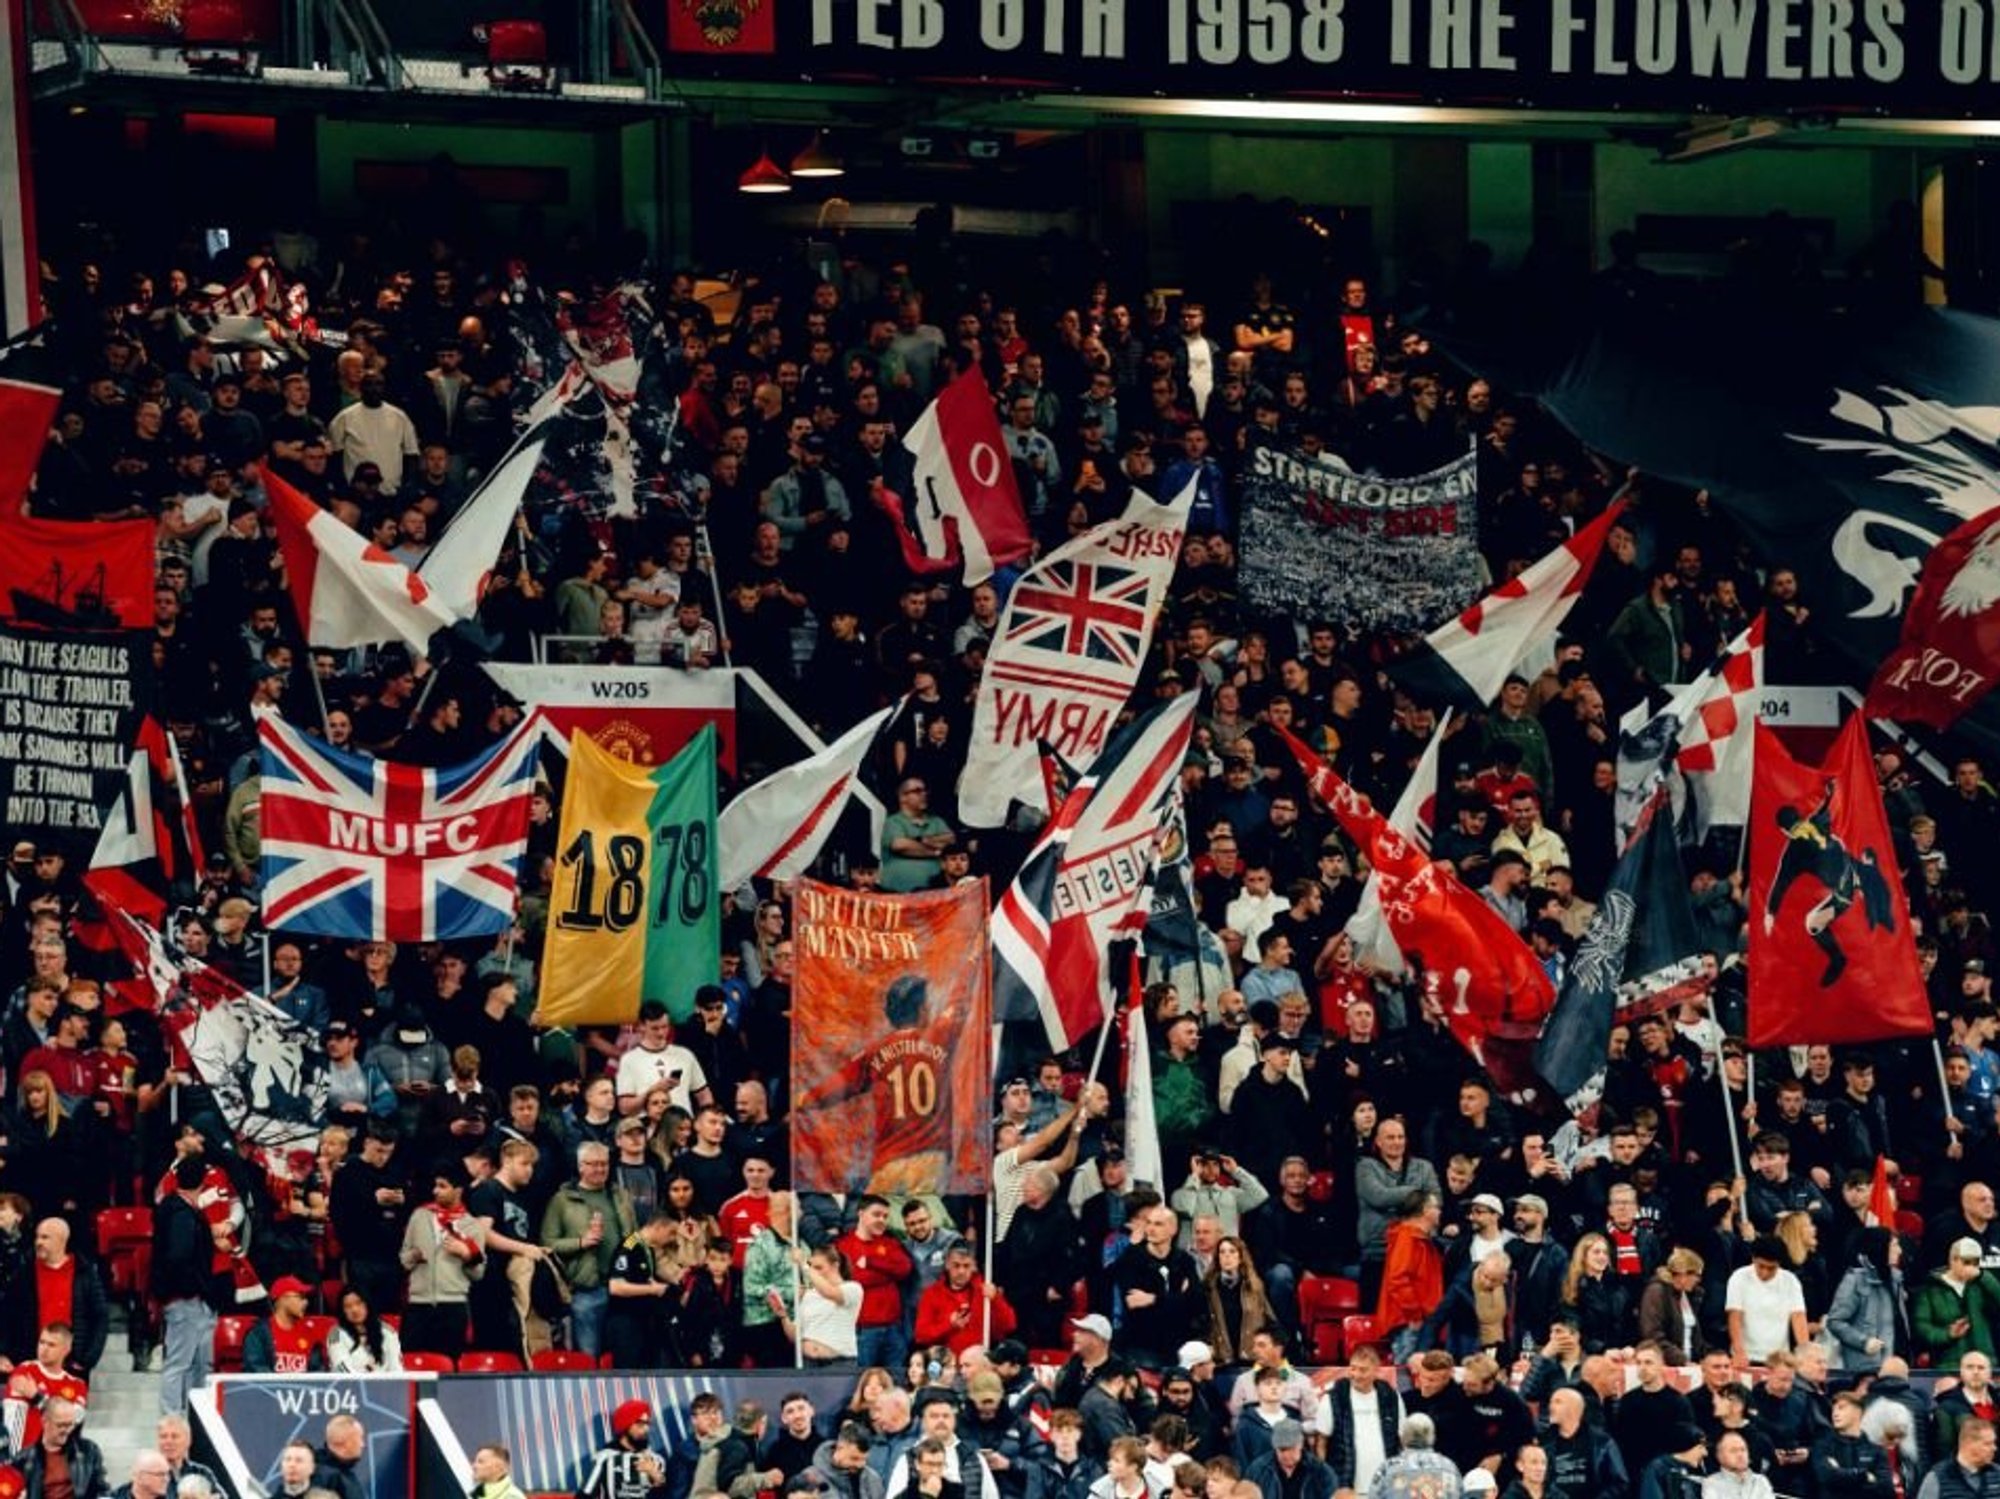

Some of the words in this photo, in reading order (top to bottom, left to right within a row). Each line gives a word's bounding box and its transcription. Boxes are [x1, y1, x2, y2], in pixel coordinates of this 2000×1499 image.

[1167, 0, 1345, 66] 1958
[1389, 0, 1518, 71] THE
[1550, 0, 1907, 84] FLOWERS
[1445, 466, 1477, 498] EN
[28, 640, 58, 669] THE
[59, 643, 130, 674] SEAGULLS
[31, 673, 60, 701] THE
[591, 681, 650, 698] W205
[4, 698, 21, 726] IS
[82, 708, 119, 737] THEY
[1759, 699, 1790, 717] 204
[90, 741, 128, 770] WILL
[13, 764, 35, 792] BE
[6, 796, 46, 825] INTO
[47, 799, 75, 827] THE
[328, 807, 480, 857] MUFC
[886, 1060, 936, 1120] 10
[275, 1387, 360, 1416] W104
